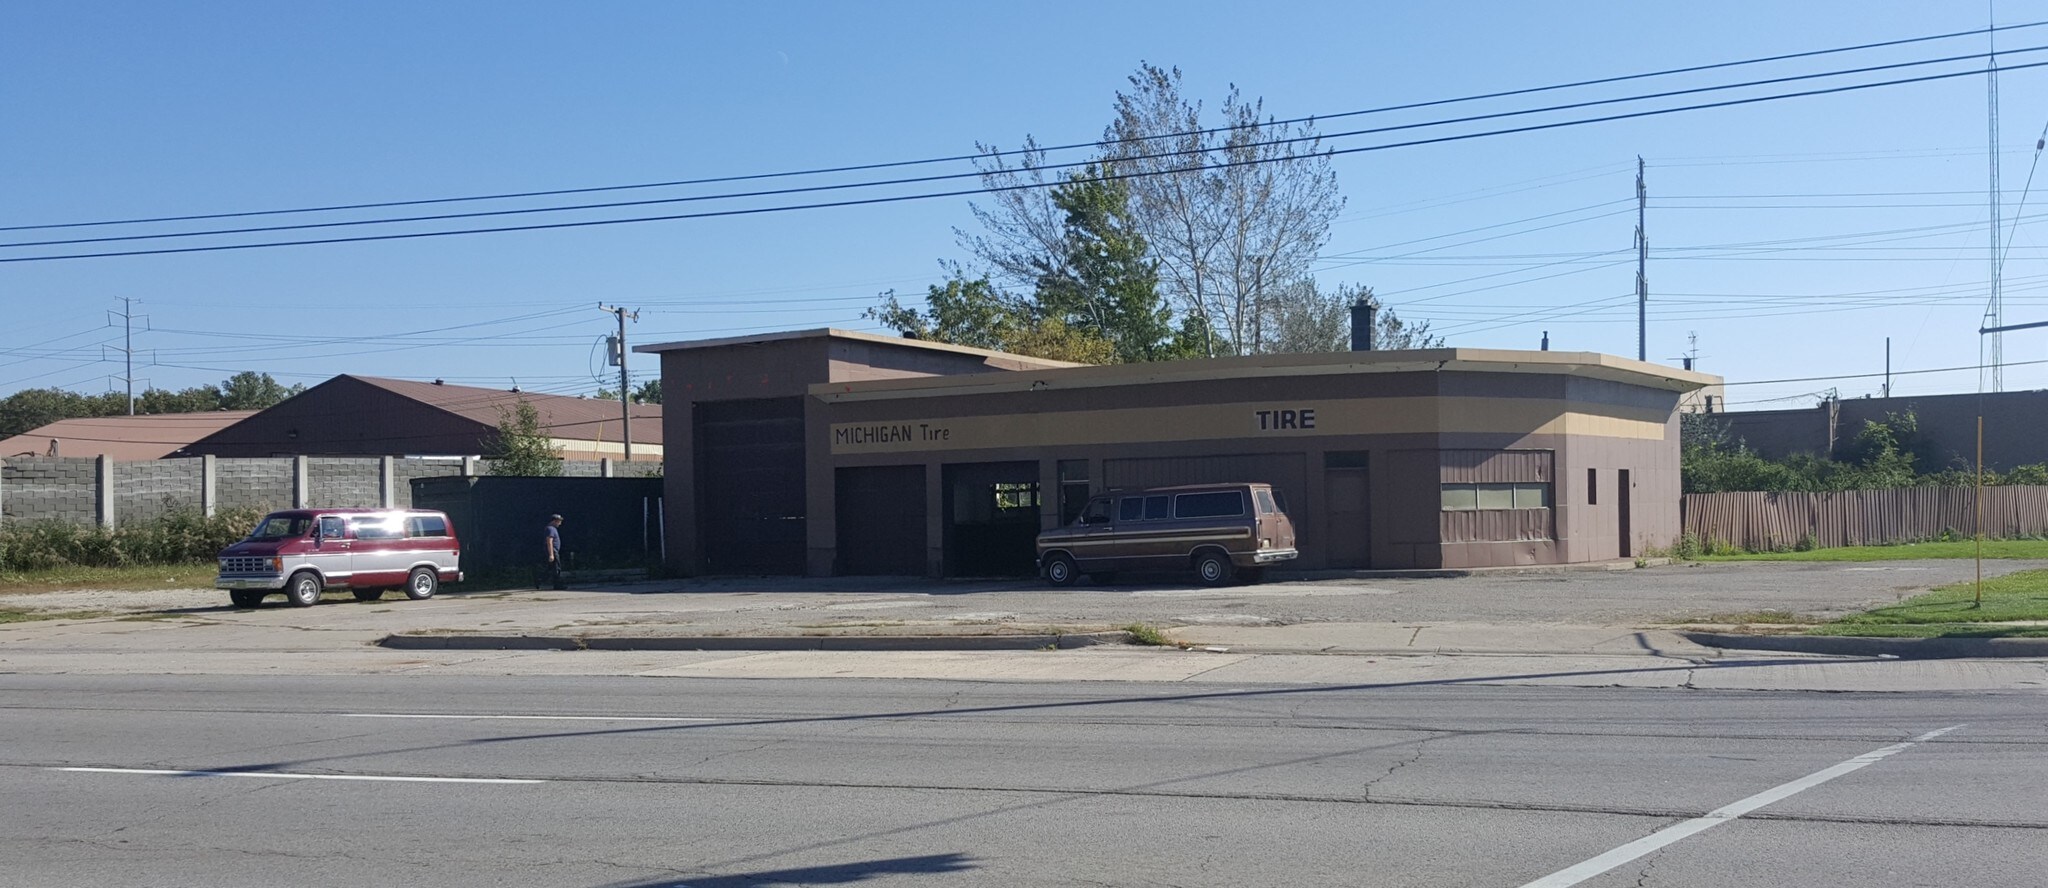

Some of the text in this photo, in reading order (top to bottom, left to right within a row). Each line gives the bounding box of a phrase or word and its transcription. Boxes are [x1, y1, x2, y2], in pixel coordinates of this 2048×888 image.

[1255, 409, 1315, 430] TIRE
[836, 424, 950, 445] MICHIGAN Tire
